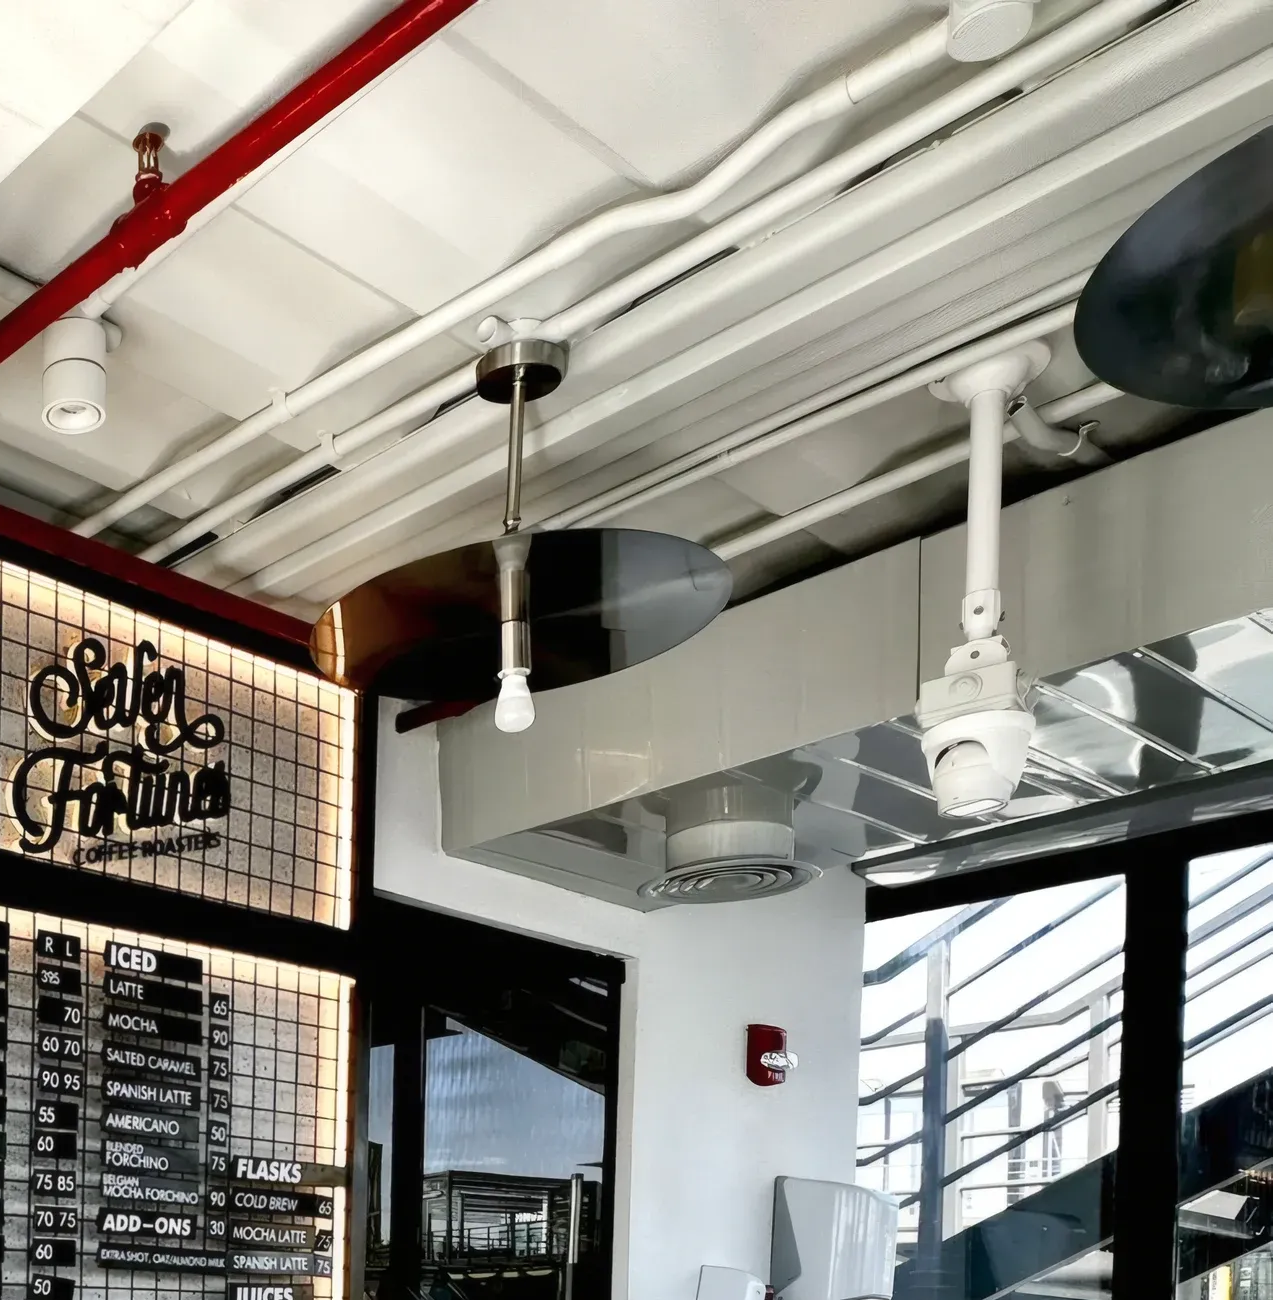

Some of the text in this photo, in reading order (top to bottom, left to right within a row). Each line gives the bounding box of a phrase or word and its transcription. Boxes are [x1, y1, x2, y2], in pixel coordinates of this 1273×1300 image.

[29, 638, 224, 753] Seven
[13, 741, 231, 854] Fortunes
[73, 830, 221, 866] COFFEE ROASTERS
[45, 937, 72, 957] R L
[110, 945, 157, 973] ICED
[110, 981, 227, 1015] LATTE 65
[64, 1007, 80, 1024] 70
[108, 1013, 228, 1045] MOCHA 90
[42, 1036, 59, 1052] 60
[64, 1040, 80, 1056] 70
[107, 1048, 228, 1076] SALTED CARAMEL 75
[42, 1071, 59, 1087] 90
[64, 1074, 80, 1091] 95
[107, 1081, 228, 1109] SPANISH LATTE 75
[38, 1106, 55, 1123] 55
[106, 1113, 226, 1141] AMERICANO 50
[37, 1136, 54, 1151] 60
[106, 1152, 225, 1171] FORCHINO 75
[236, 1158, 302, 1183] FLASKS
[36, 1174, 53, 1190] 75
[57, 1175, 74, 1191] 85
[103, 1185, 225, 1207] MOCHA FORCHINO 90
[235, 1192, 332, 1215] COLD BREW 65
[37, 1211, 53, 1227] 70
[59, 1212, 76, 1228] 75
[103, 1213, 225, 1236] ADD-ONS 30
[233, 1226, 332, 1249] MOCHA LATTE 75
[35, 1245, 53, 1259] 60
[233, 1255, 330, 1274] SPANISH LATTE 75
[33, 1280, 51, 1295] 50
